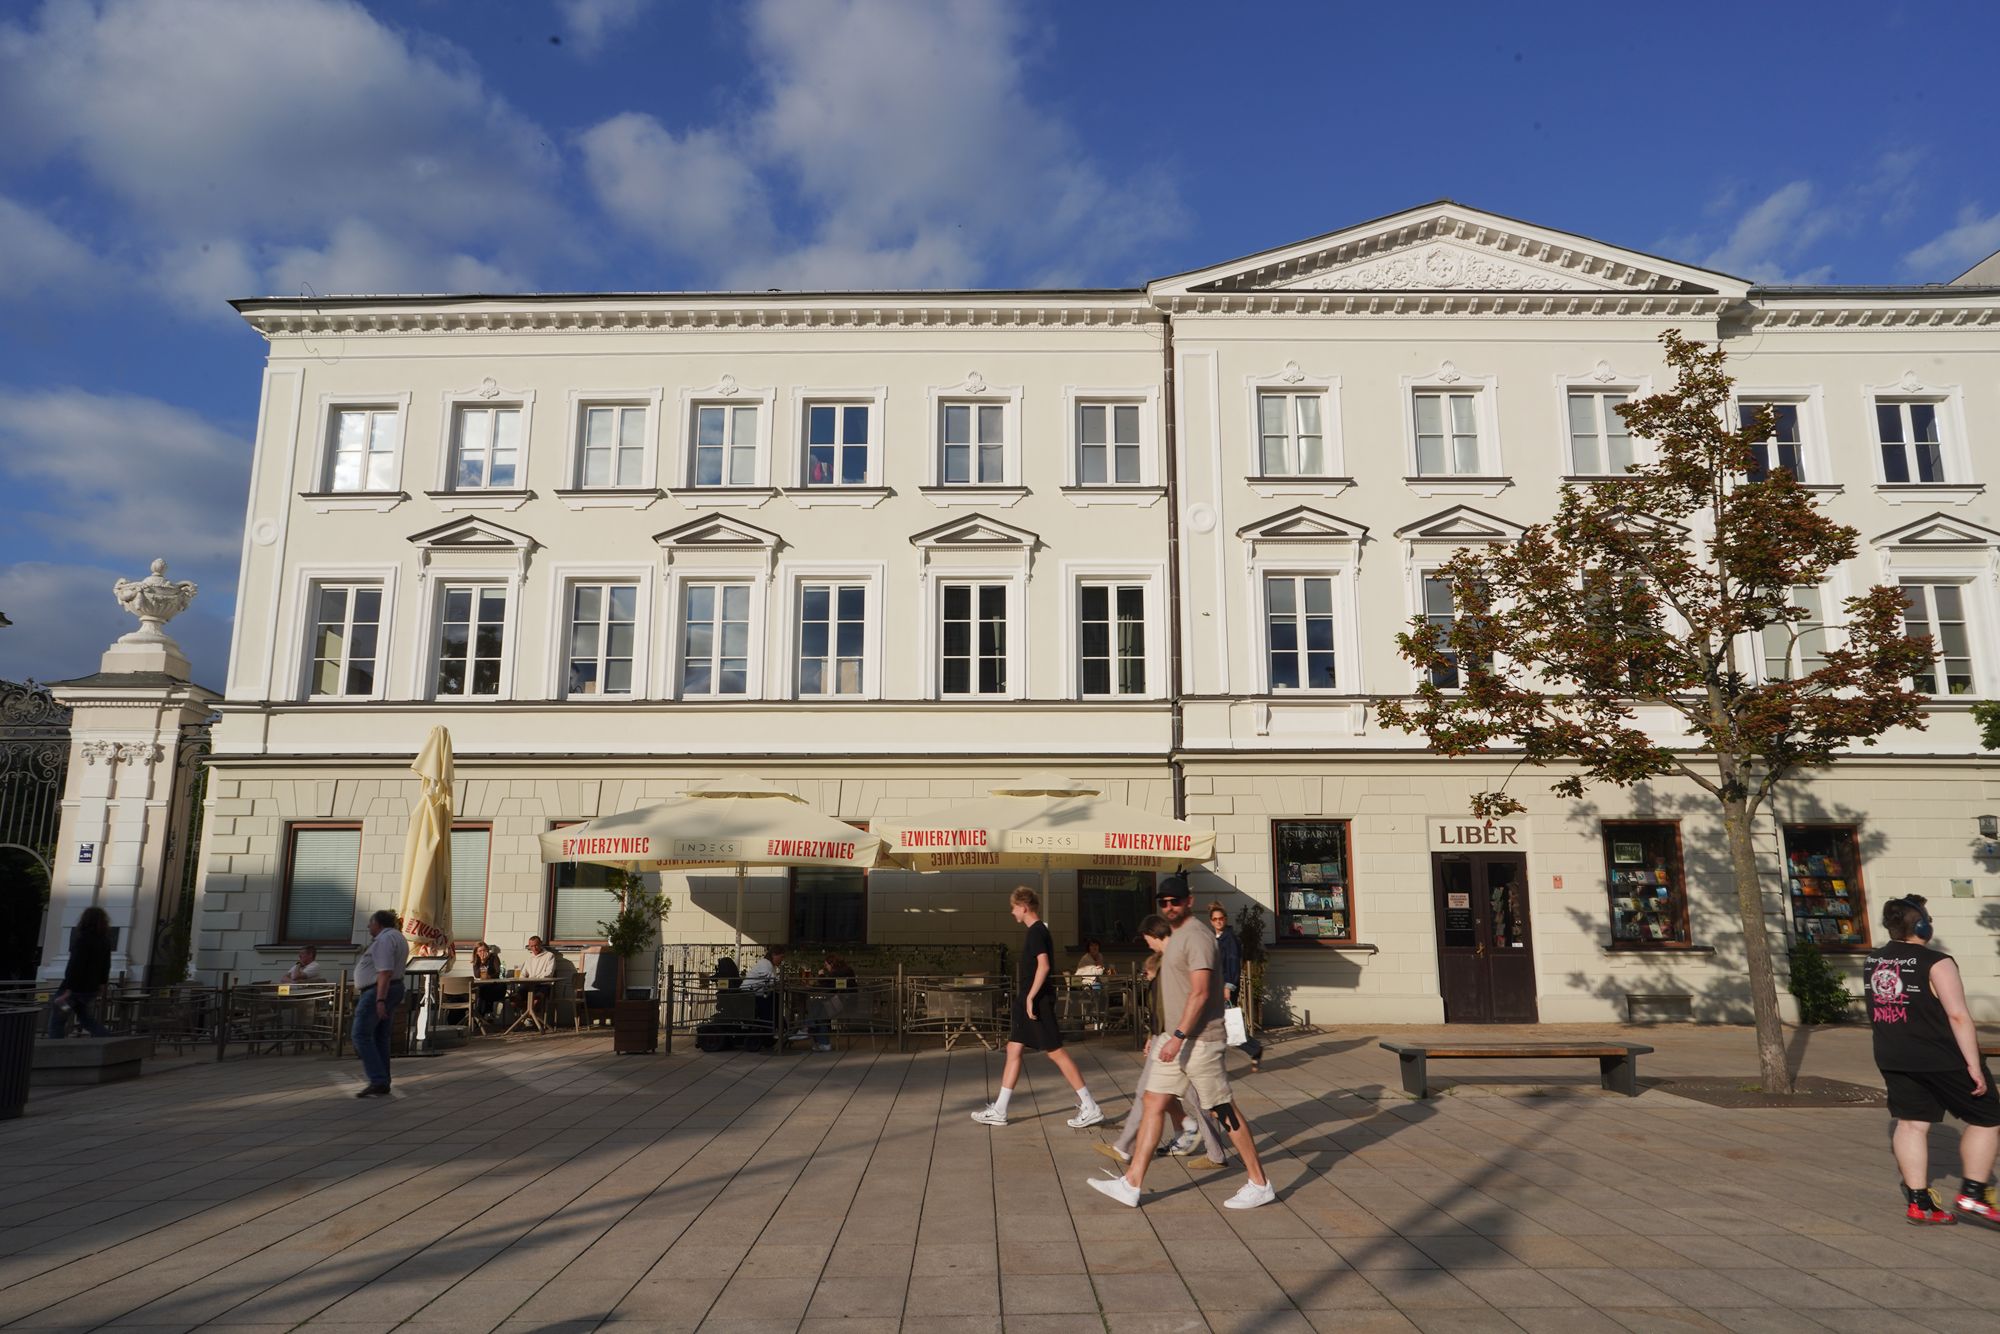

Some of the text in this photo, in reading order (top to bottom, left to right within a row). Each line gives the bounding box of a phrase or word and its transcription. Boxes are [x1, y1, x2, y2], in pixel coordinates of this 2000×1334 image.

[908, 829, 987, 847] ZWIERZYNIEC
[1019, 836, 1072, 846] INDEKS
[1111, 832, 1192, 852] ZWIERZYNIEC
[1439, 825, 1518, 844] LIBER
[681, 843, 734, 853] INDEKS
[773, 839, 856, 860] ZWIERZYNIEC
